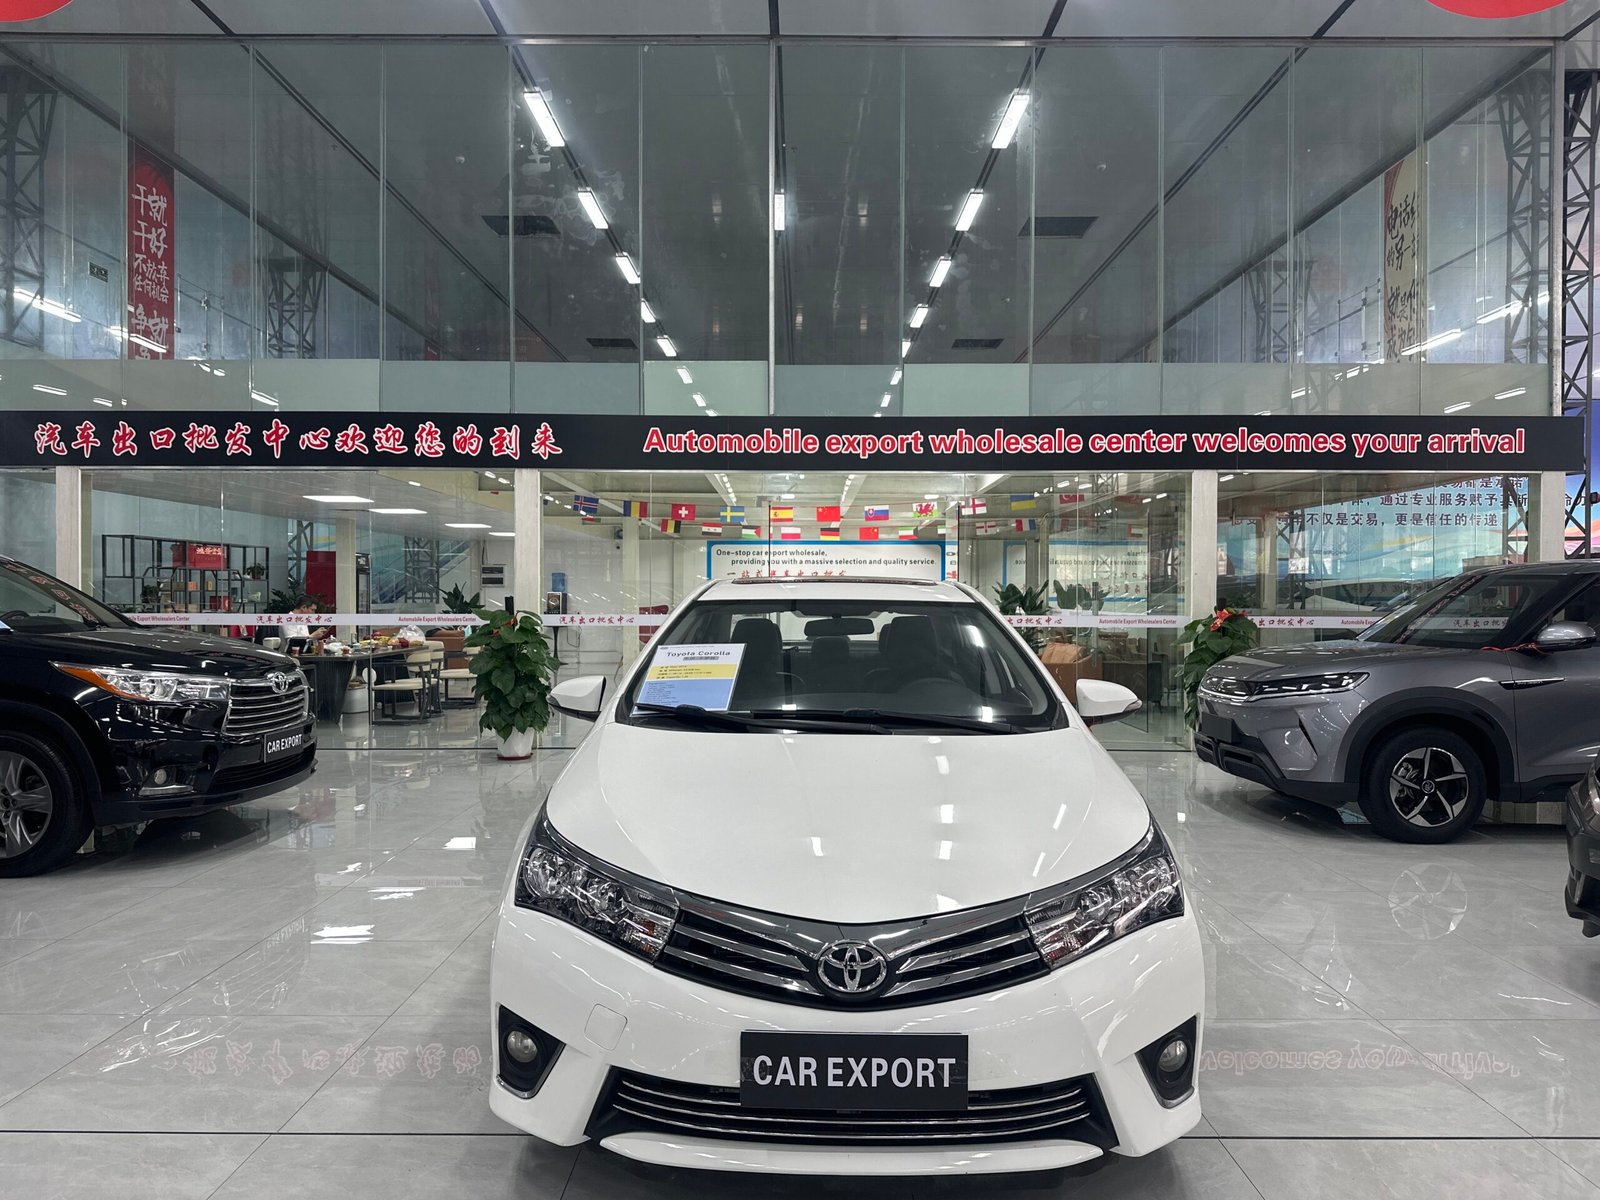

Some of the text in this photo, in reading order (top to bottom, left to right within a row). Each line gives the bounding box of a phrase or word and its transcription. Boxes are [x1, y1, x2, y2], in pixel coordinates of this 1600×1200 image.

[34, 418, 563, 459] 汽车出口批发中心欢迎您的到来
[643, 427, 1525, 458] Automobile export wholesale center welcomes your arrival
[716, 549, 751, 558] One-stop
[789, 549, 828, 557] wholesale,
[731, 558, 766, 567] providing
[782, 557, 798, 565] with
[835, 557, 867, 565] selection
[883, 558, 908, 567] quality
[256, 614, 333, 625] 汽车出口批发中心
[559, 616, 635, 625] 汽车出口批发中心
[267, 733, 303, 754] CAR EXPORT
[753, 1055, 956, 1088] CAR EXPORT
